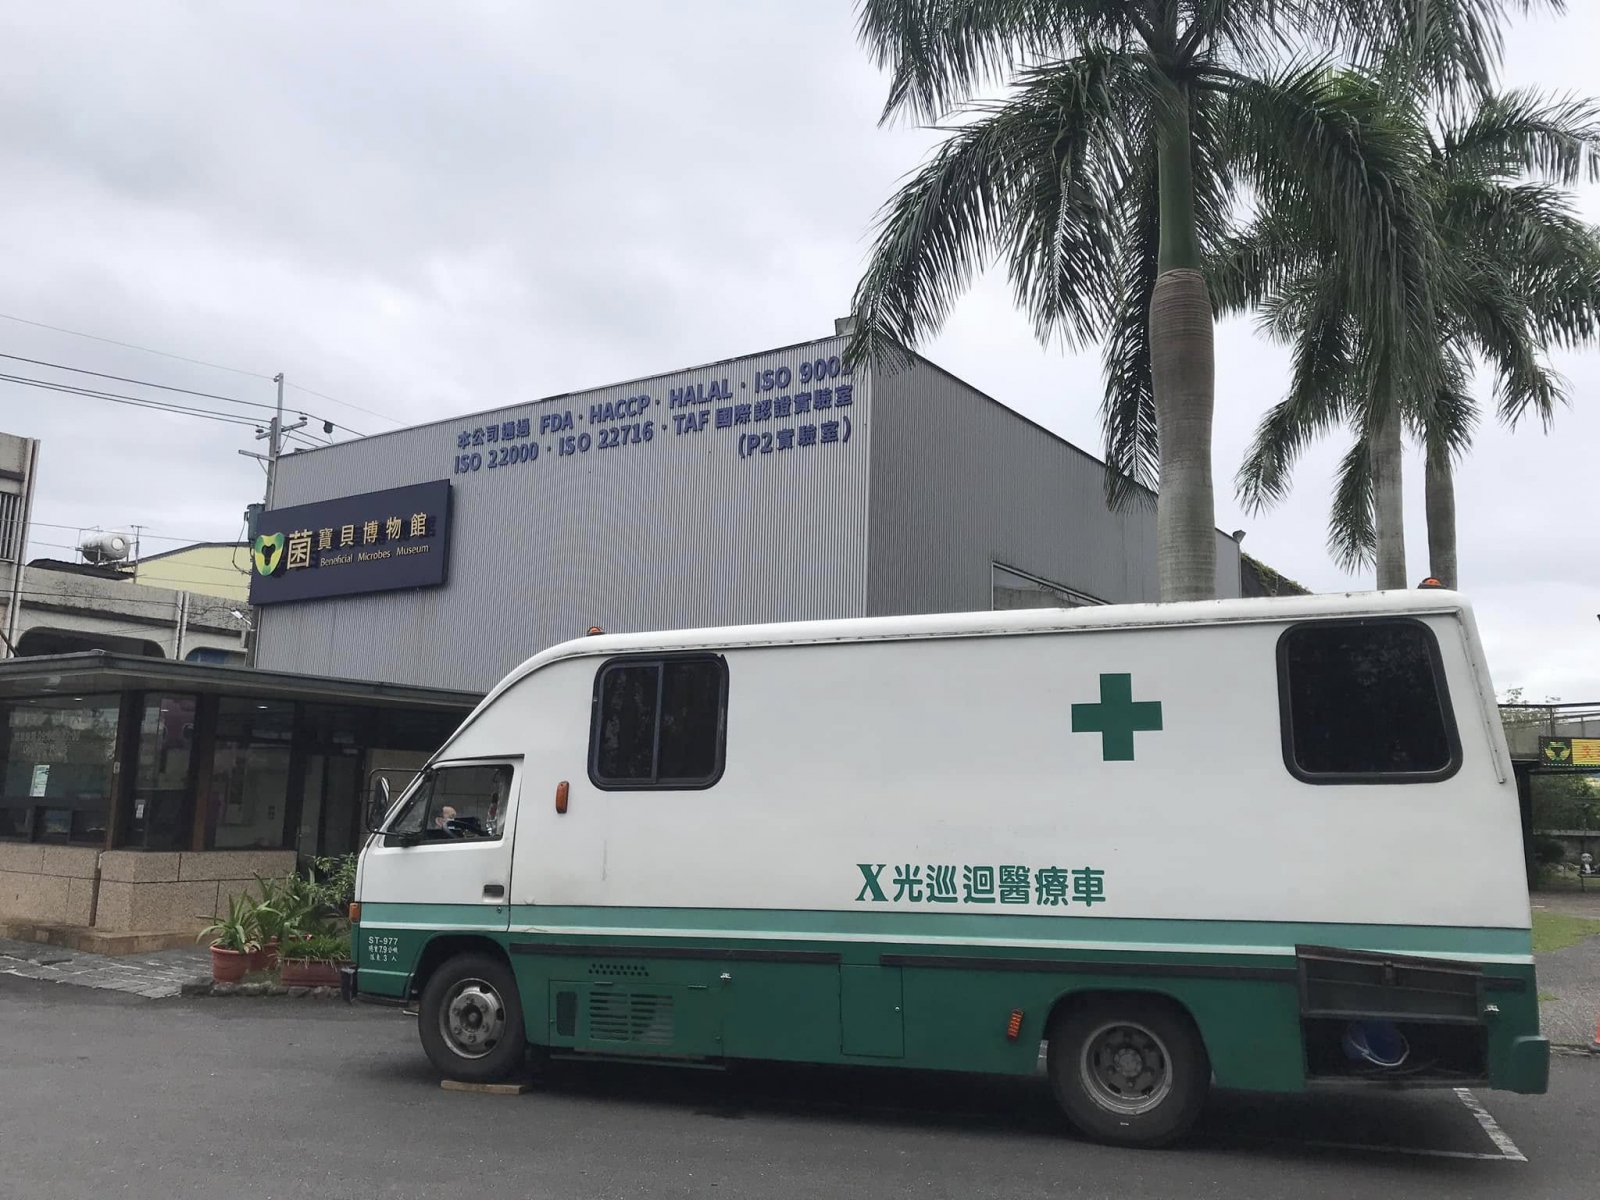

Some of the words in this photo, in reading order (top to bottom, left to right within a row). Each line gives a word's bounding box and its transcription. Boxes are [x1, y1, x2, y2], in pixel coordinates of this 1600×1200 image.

[454, 452, 482, 475] ISO
[487, 441, 539, 469] 22000
[558, 432, 591, 457] ISO
[598, 420, 654, 449] 22716
[673, 409, 709, 435] TAF
[714, 383, 853, 429] 國際認證實驗室
[457, 418, 530, 449] 本公司通過
[539, 411, 574, 435] FDA
[588, 394, 651, 425] HACCP
[668, 378, 733, 409] HALAL
[754, 366, 791, 394] ISO
[738, 415, 852, 459] (P2實驗室)
[286, 512, 427, 570] 菌寶貝博物館
[320, 551, 353, 567] Beneficial
[357, 549, 391, 562] Microbes
[396, 543, 429, 556] Museum
[854, 863, 1106, 907] X光巡迴醫療車
[368, 936, 399, 945] ST-977
